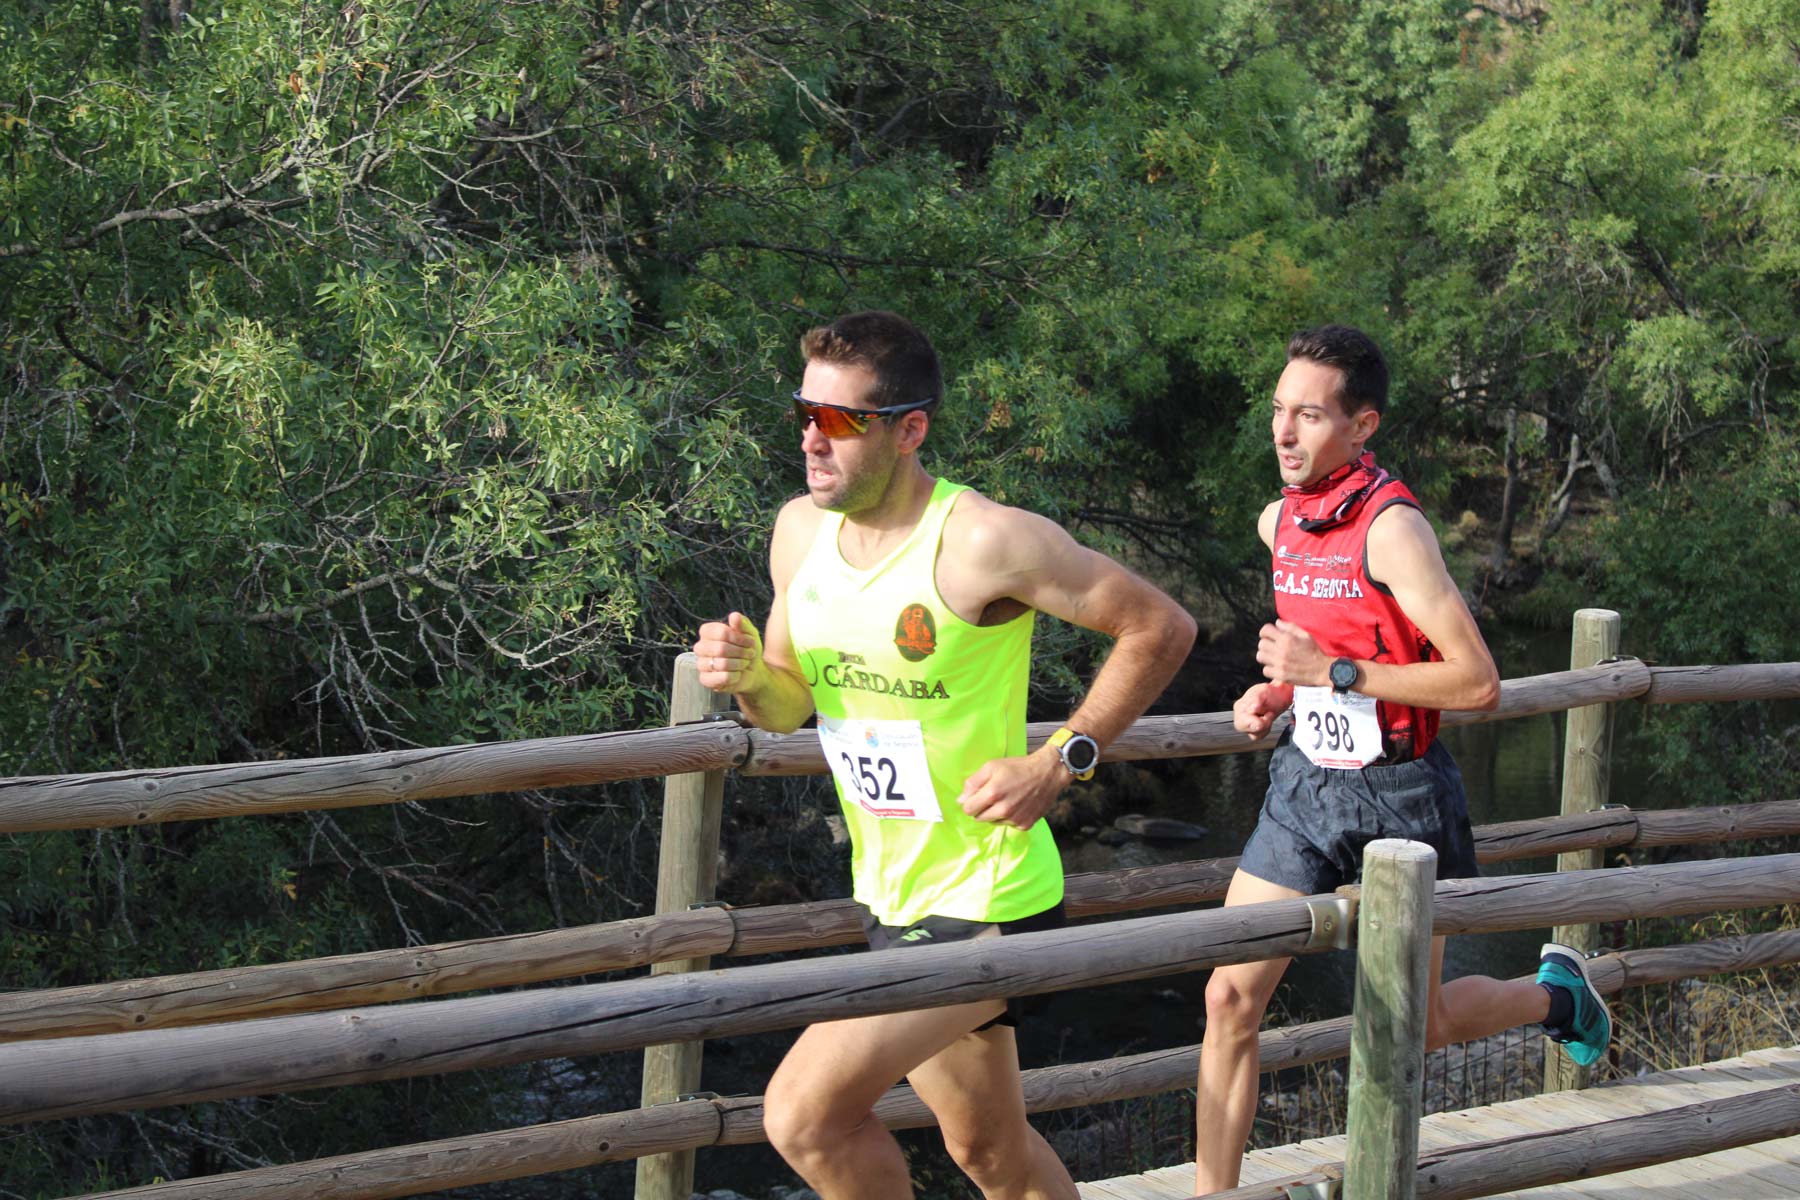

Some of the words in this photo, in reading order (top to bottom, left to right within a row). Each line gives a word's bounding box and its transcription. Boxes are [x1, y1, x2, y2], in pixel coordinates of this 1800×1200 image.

[1311, 577, 1364, 599] SEGOVIA
[823, 664, 950, 699] CÁRDABA
[1307, 710, 1355, 753] 398
[841, 751, 906, 801] 352
